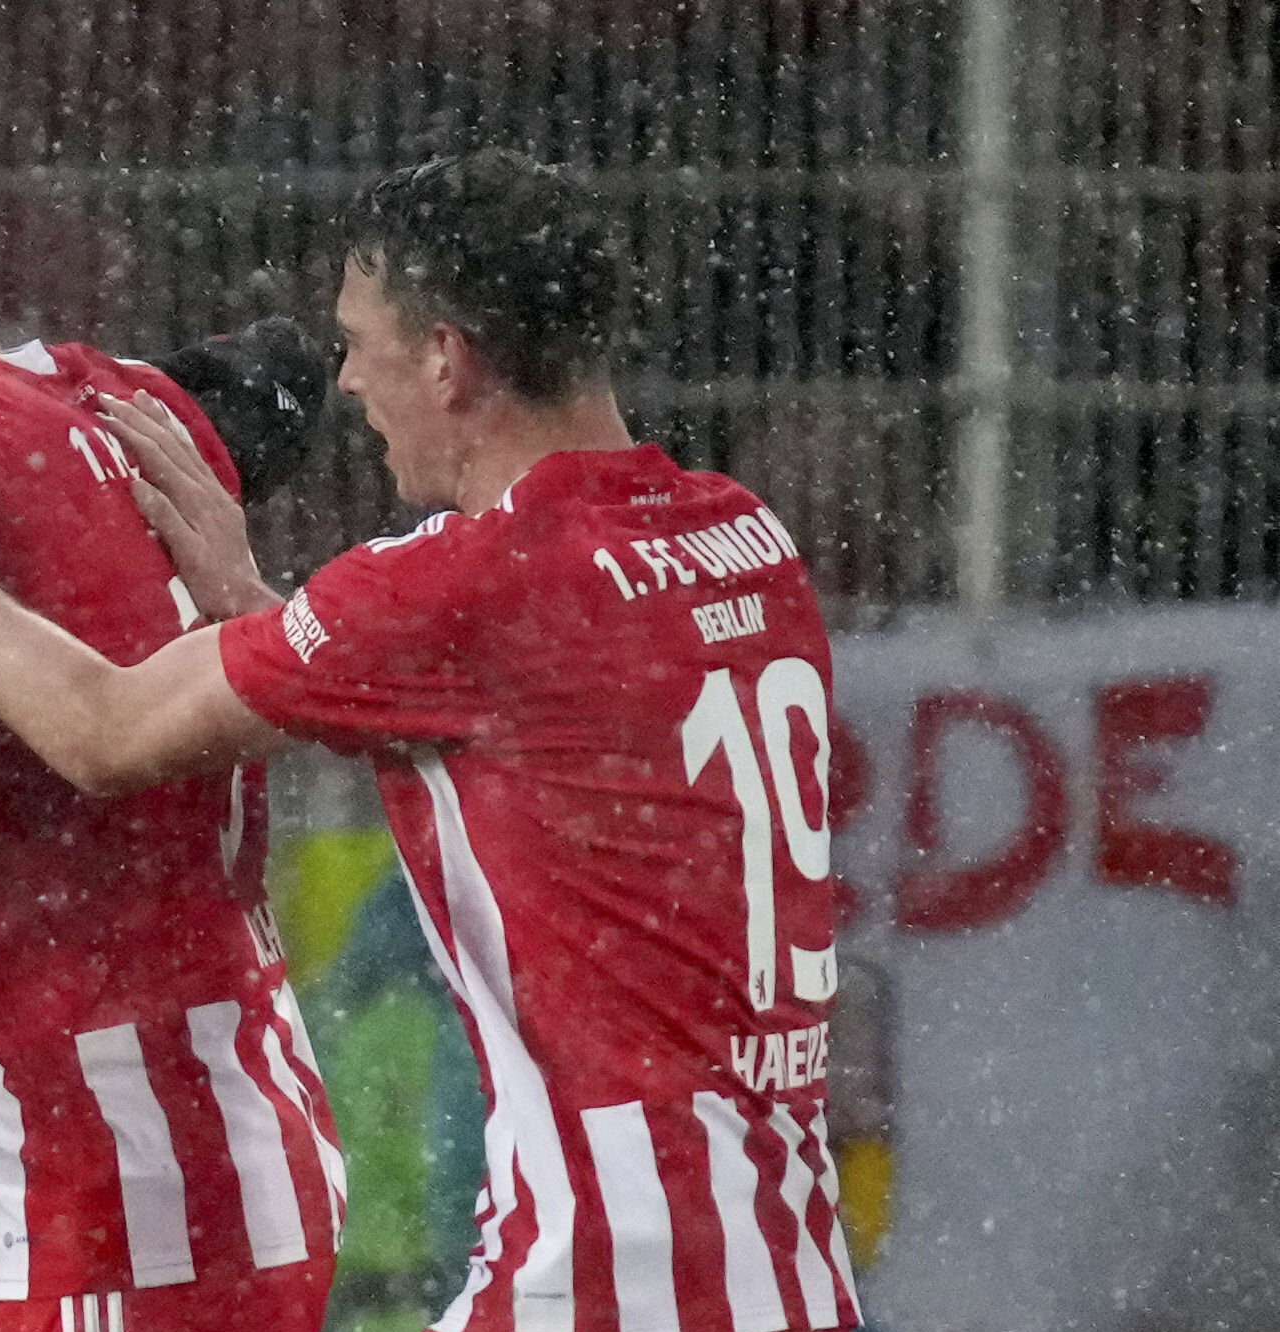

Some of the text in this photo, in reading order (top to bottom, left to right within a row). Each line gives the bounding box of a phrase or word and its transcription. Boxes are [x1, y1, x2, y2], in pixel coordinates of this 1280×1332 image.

[593, 506, 799, 601] 1. FC UNION
[692, 592, 767, 644] BERLIN
[681, 655, 838, 1012] 19
